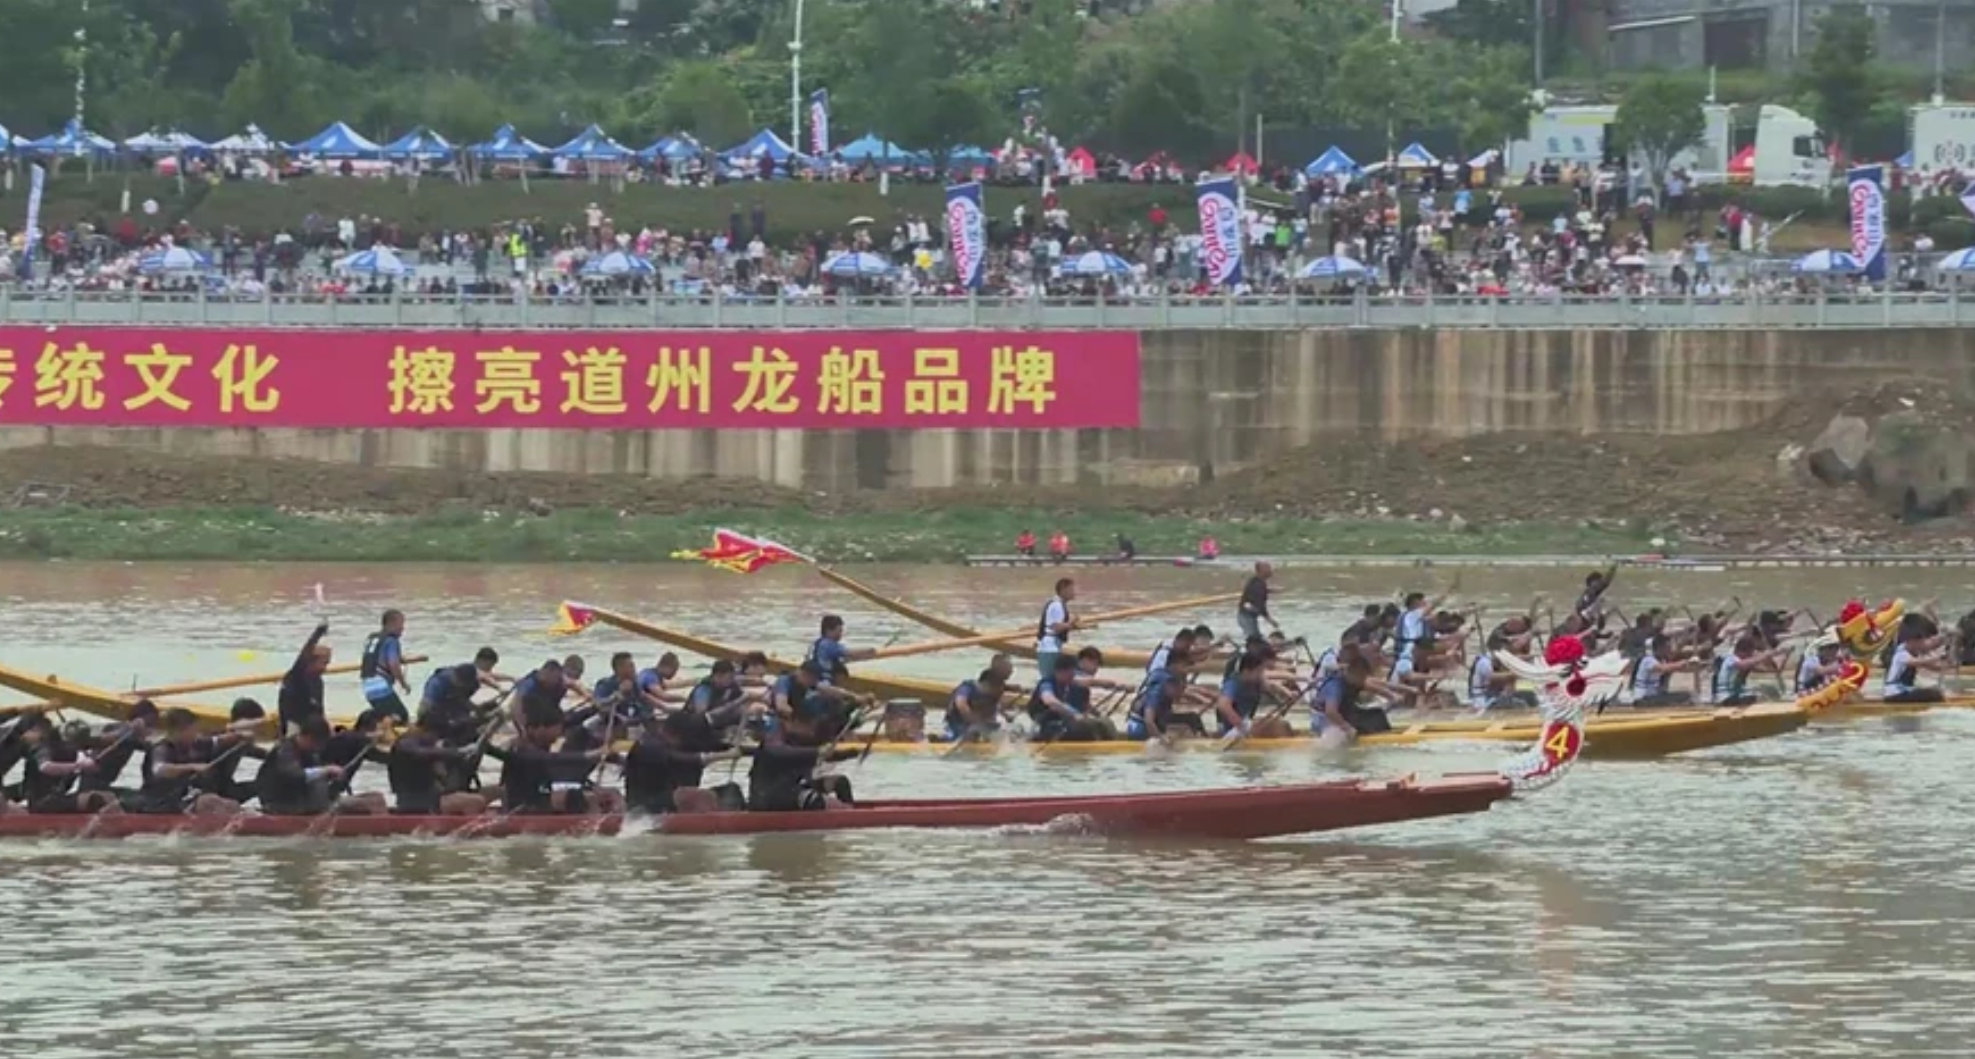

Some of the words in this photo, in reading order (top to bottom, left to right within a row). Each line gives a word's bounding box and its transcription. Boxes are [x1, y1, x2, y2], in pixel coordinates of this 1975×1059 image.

[0, 342, 280, 412] 统文化
[387, 345, 1056, 414] 擦亮道州龙船品牌
[1545, 725, 1569, 759] 4
